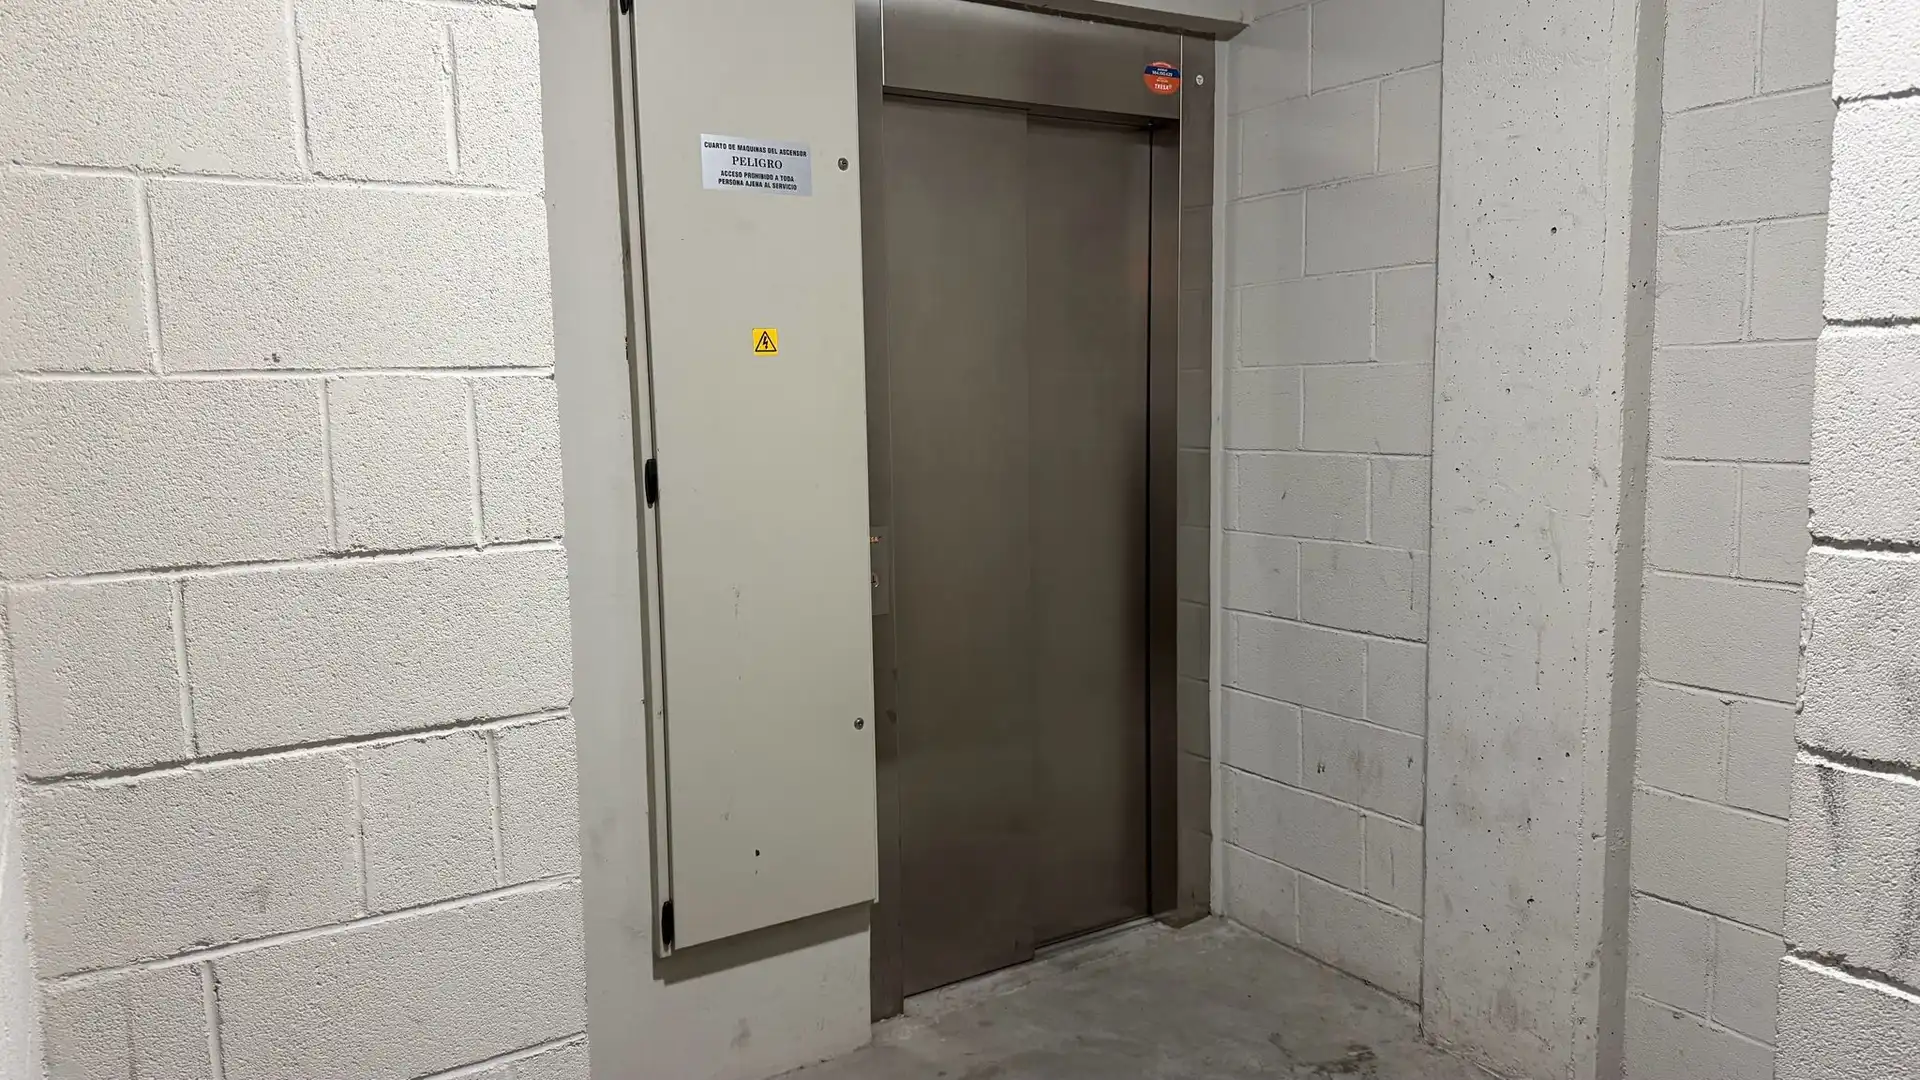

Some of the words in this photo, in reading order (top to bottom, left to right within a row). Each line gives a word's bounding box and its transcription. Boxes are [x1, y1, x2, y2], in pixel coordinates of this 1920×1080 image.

[704, 141, 727, 150] CUARTO
[728, 143, 736, 151] DE
[737, 144, 767, 154] MAQUINAS
[767, 147, 778, 155] DEL
[779, 149, 807, 157] ASCENSOR
[732, 156, 783, 169] PELIGRO
[720, 170, 743, 178] ACCESO
[743, 172, 774, 181] PROHIBIDO
[718, 178, 744, 186] PERSONA
[745, 180, 763, 188] AJENA
[772, 182, 797, 191] SERVICIO
